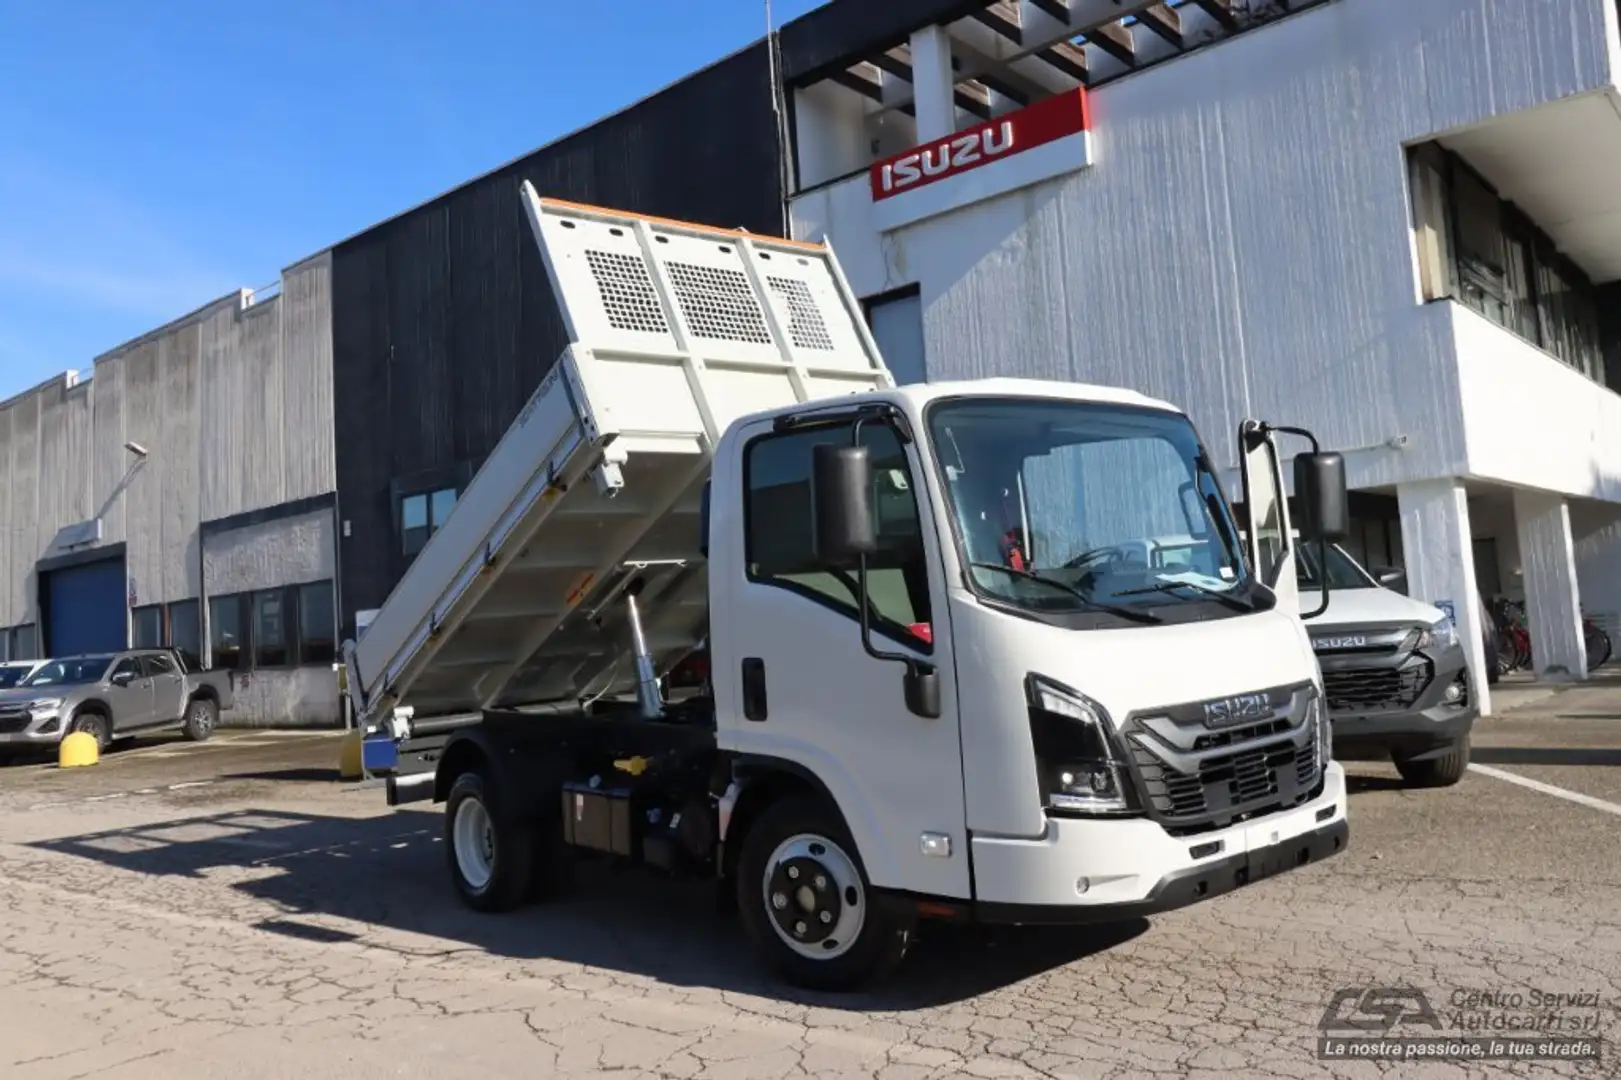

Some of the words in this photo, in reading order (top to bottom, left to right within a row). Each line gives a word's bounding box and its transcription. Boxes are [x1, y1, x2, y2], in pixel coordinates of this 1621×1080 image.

[881, 121, 1013, 191] ISUZU
[1311, 635, 1367, 649] ISUZU
[1203, 693, 1271, 726] ISUZU
